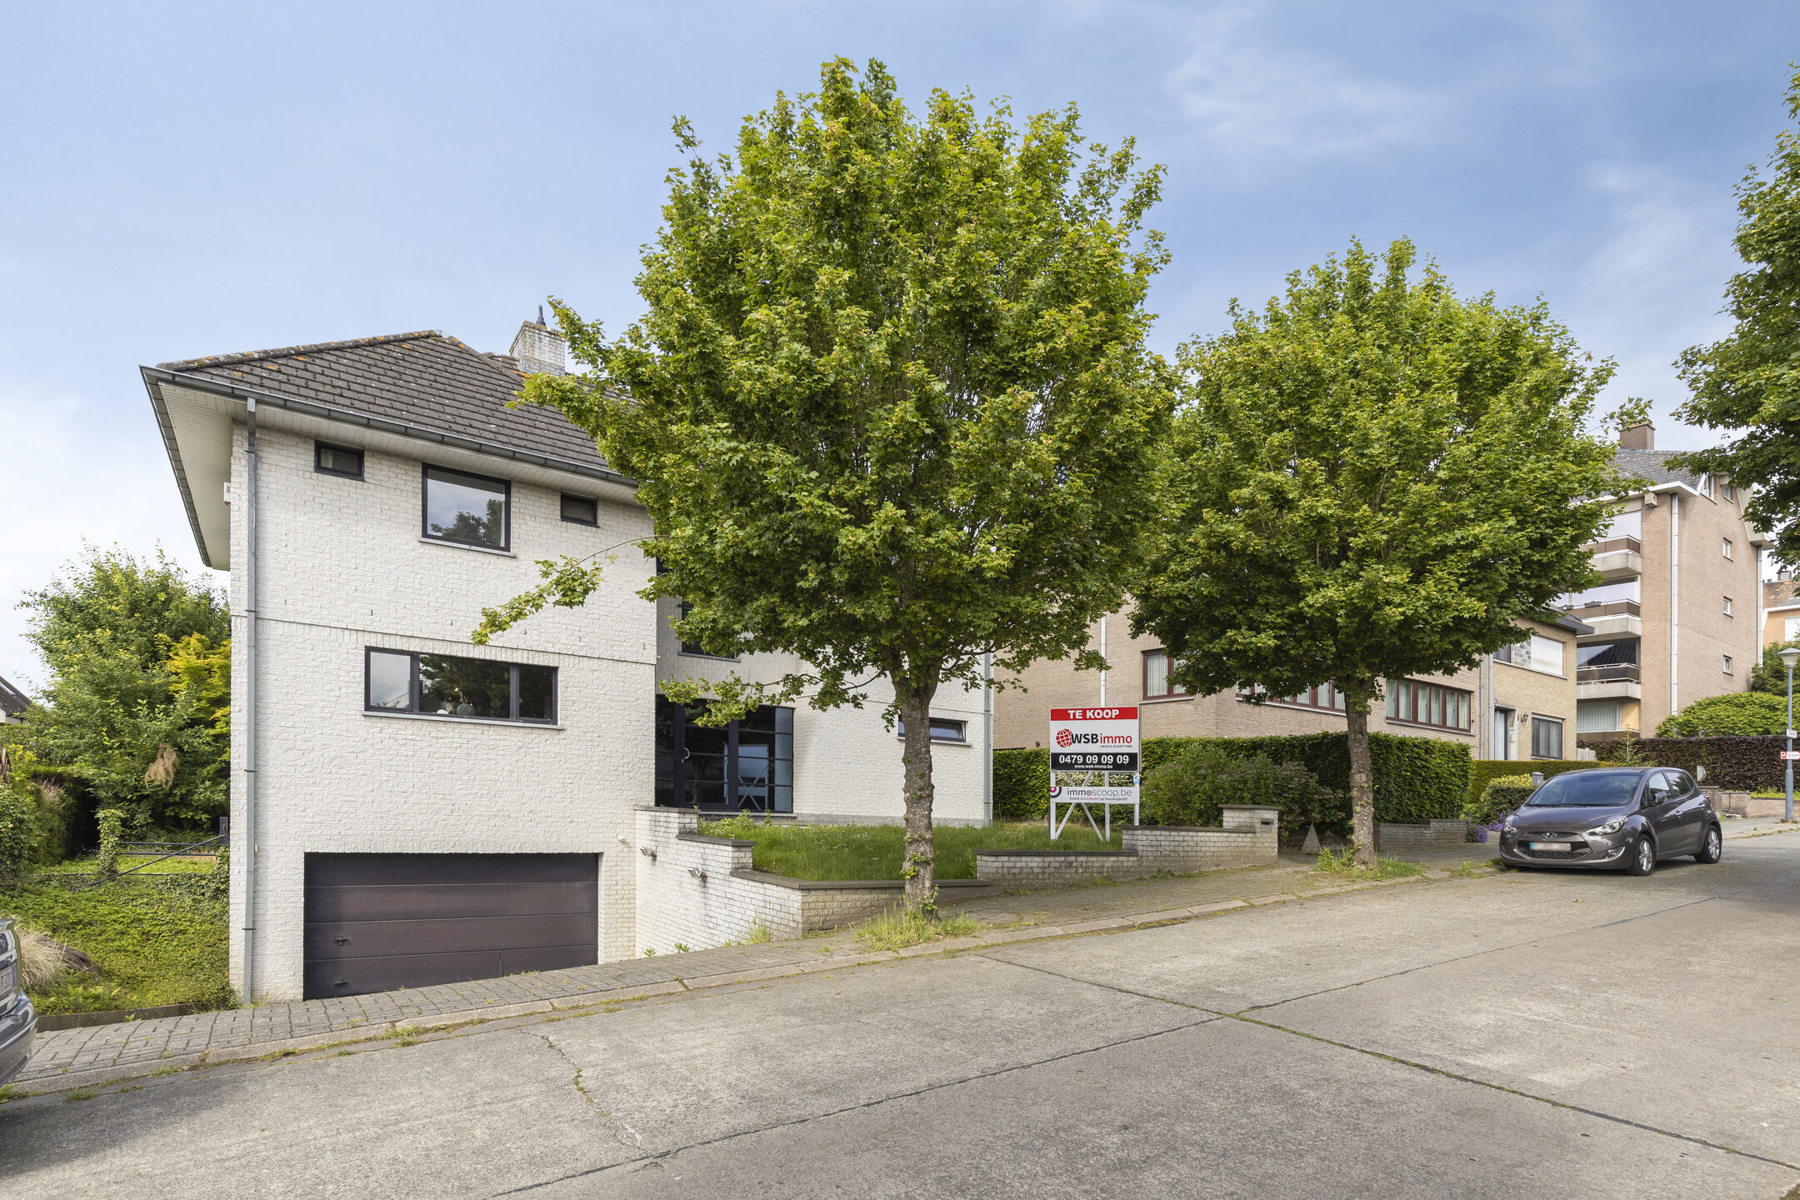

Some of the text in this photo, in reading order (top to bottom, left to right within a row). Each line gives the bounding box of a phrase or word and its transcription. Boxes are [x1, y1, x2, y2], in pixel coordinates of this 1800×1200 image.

[1068, 709, 1119, 719] TE KOOP
[1059, 754, 1129, 764] 0479 09 09 09
[1067, 787, 1133, 797] immoscoop.be
